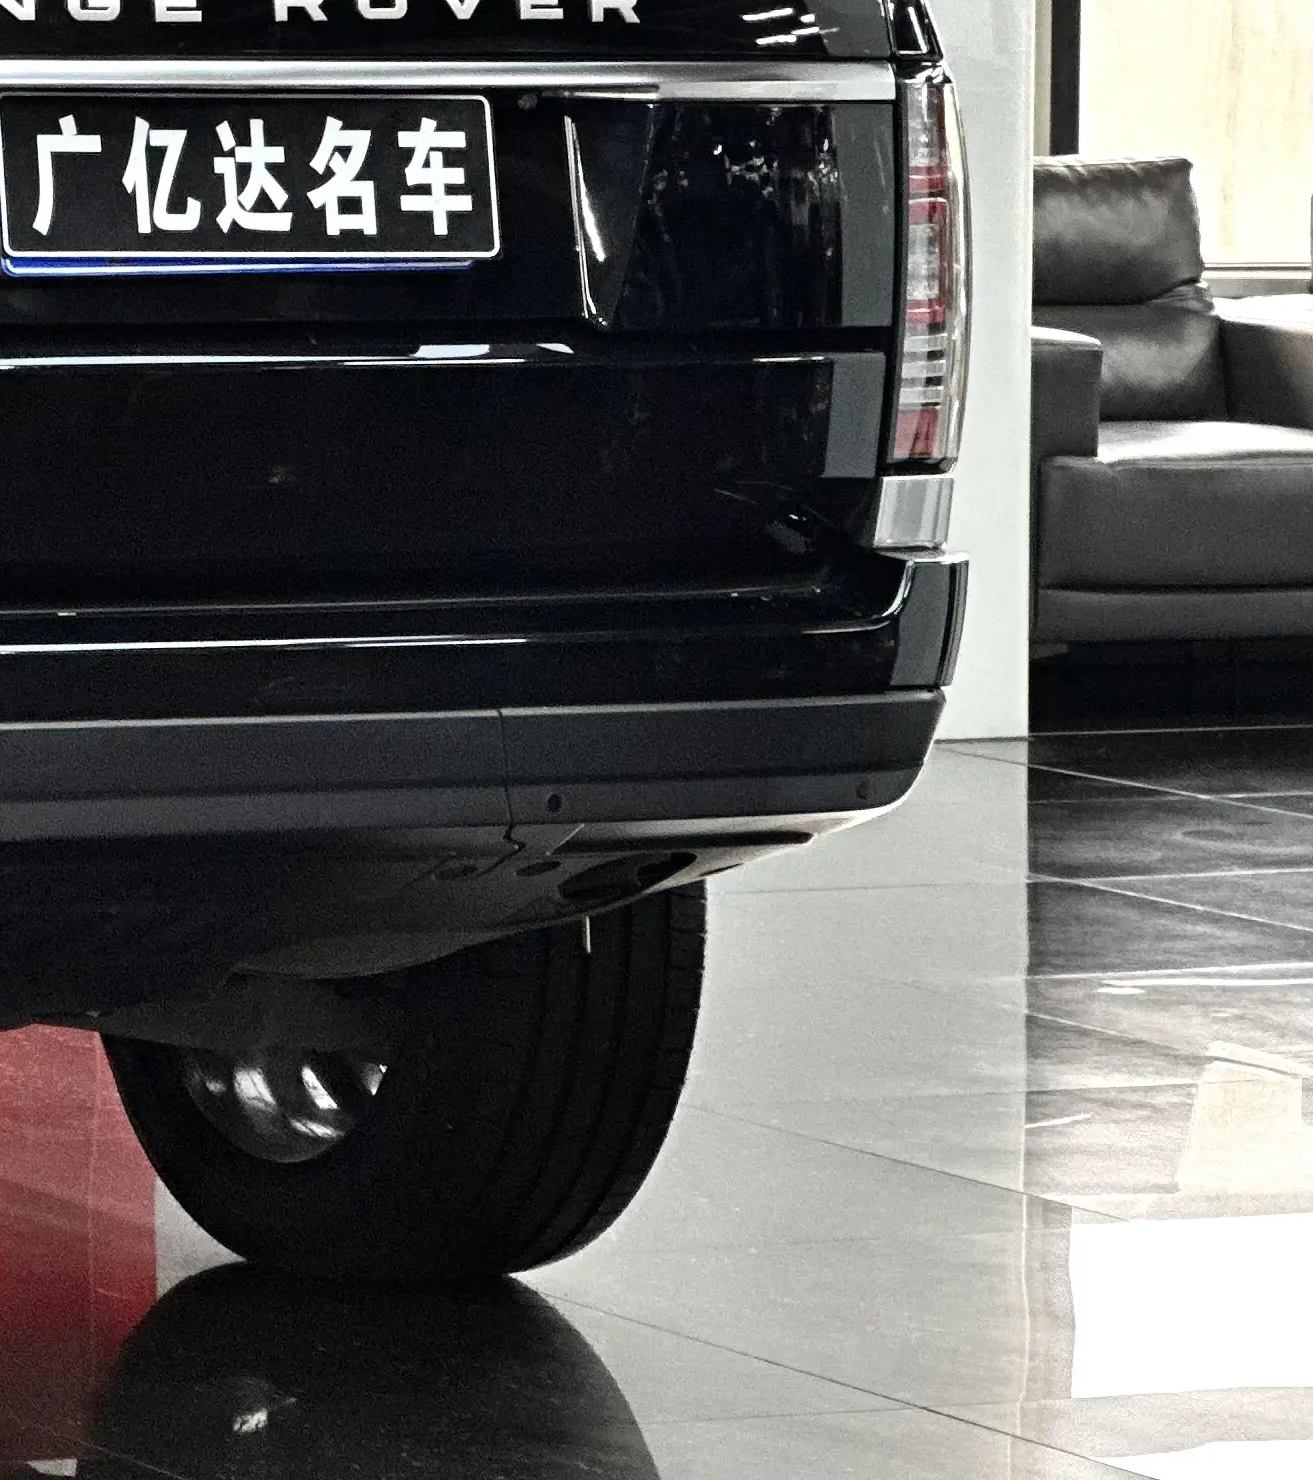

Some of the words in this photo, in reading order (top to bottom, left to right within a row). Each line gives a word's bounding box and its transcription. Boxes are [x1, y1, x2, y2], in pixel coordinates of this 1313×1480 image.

[32, 114, 473, 237] 广亿达名车
